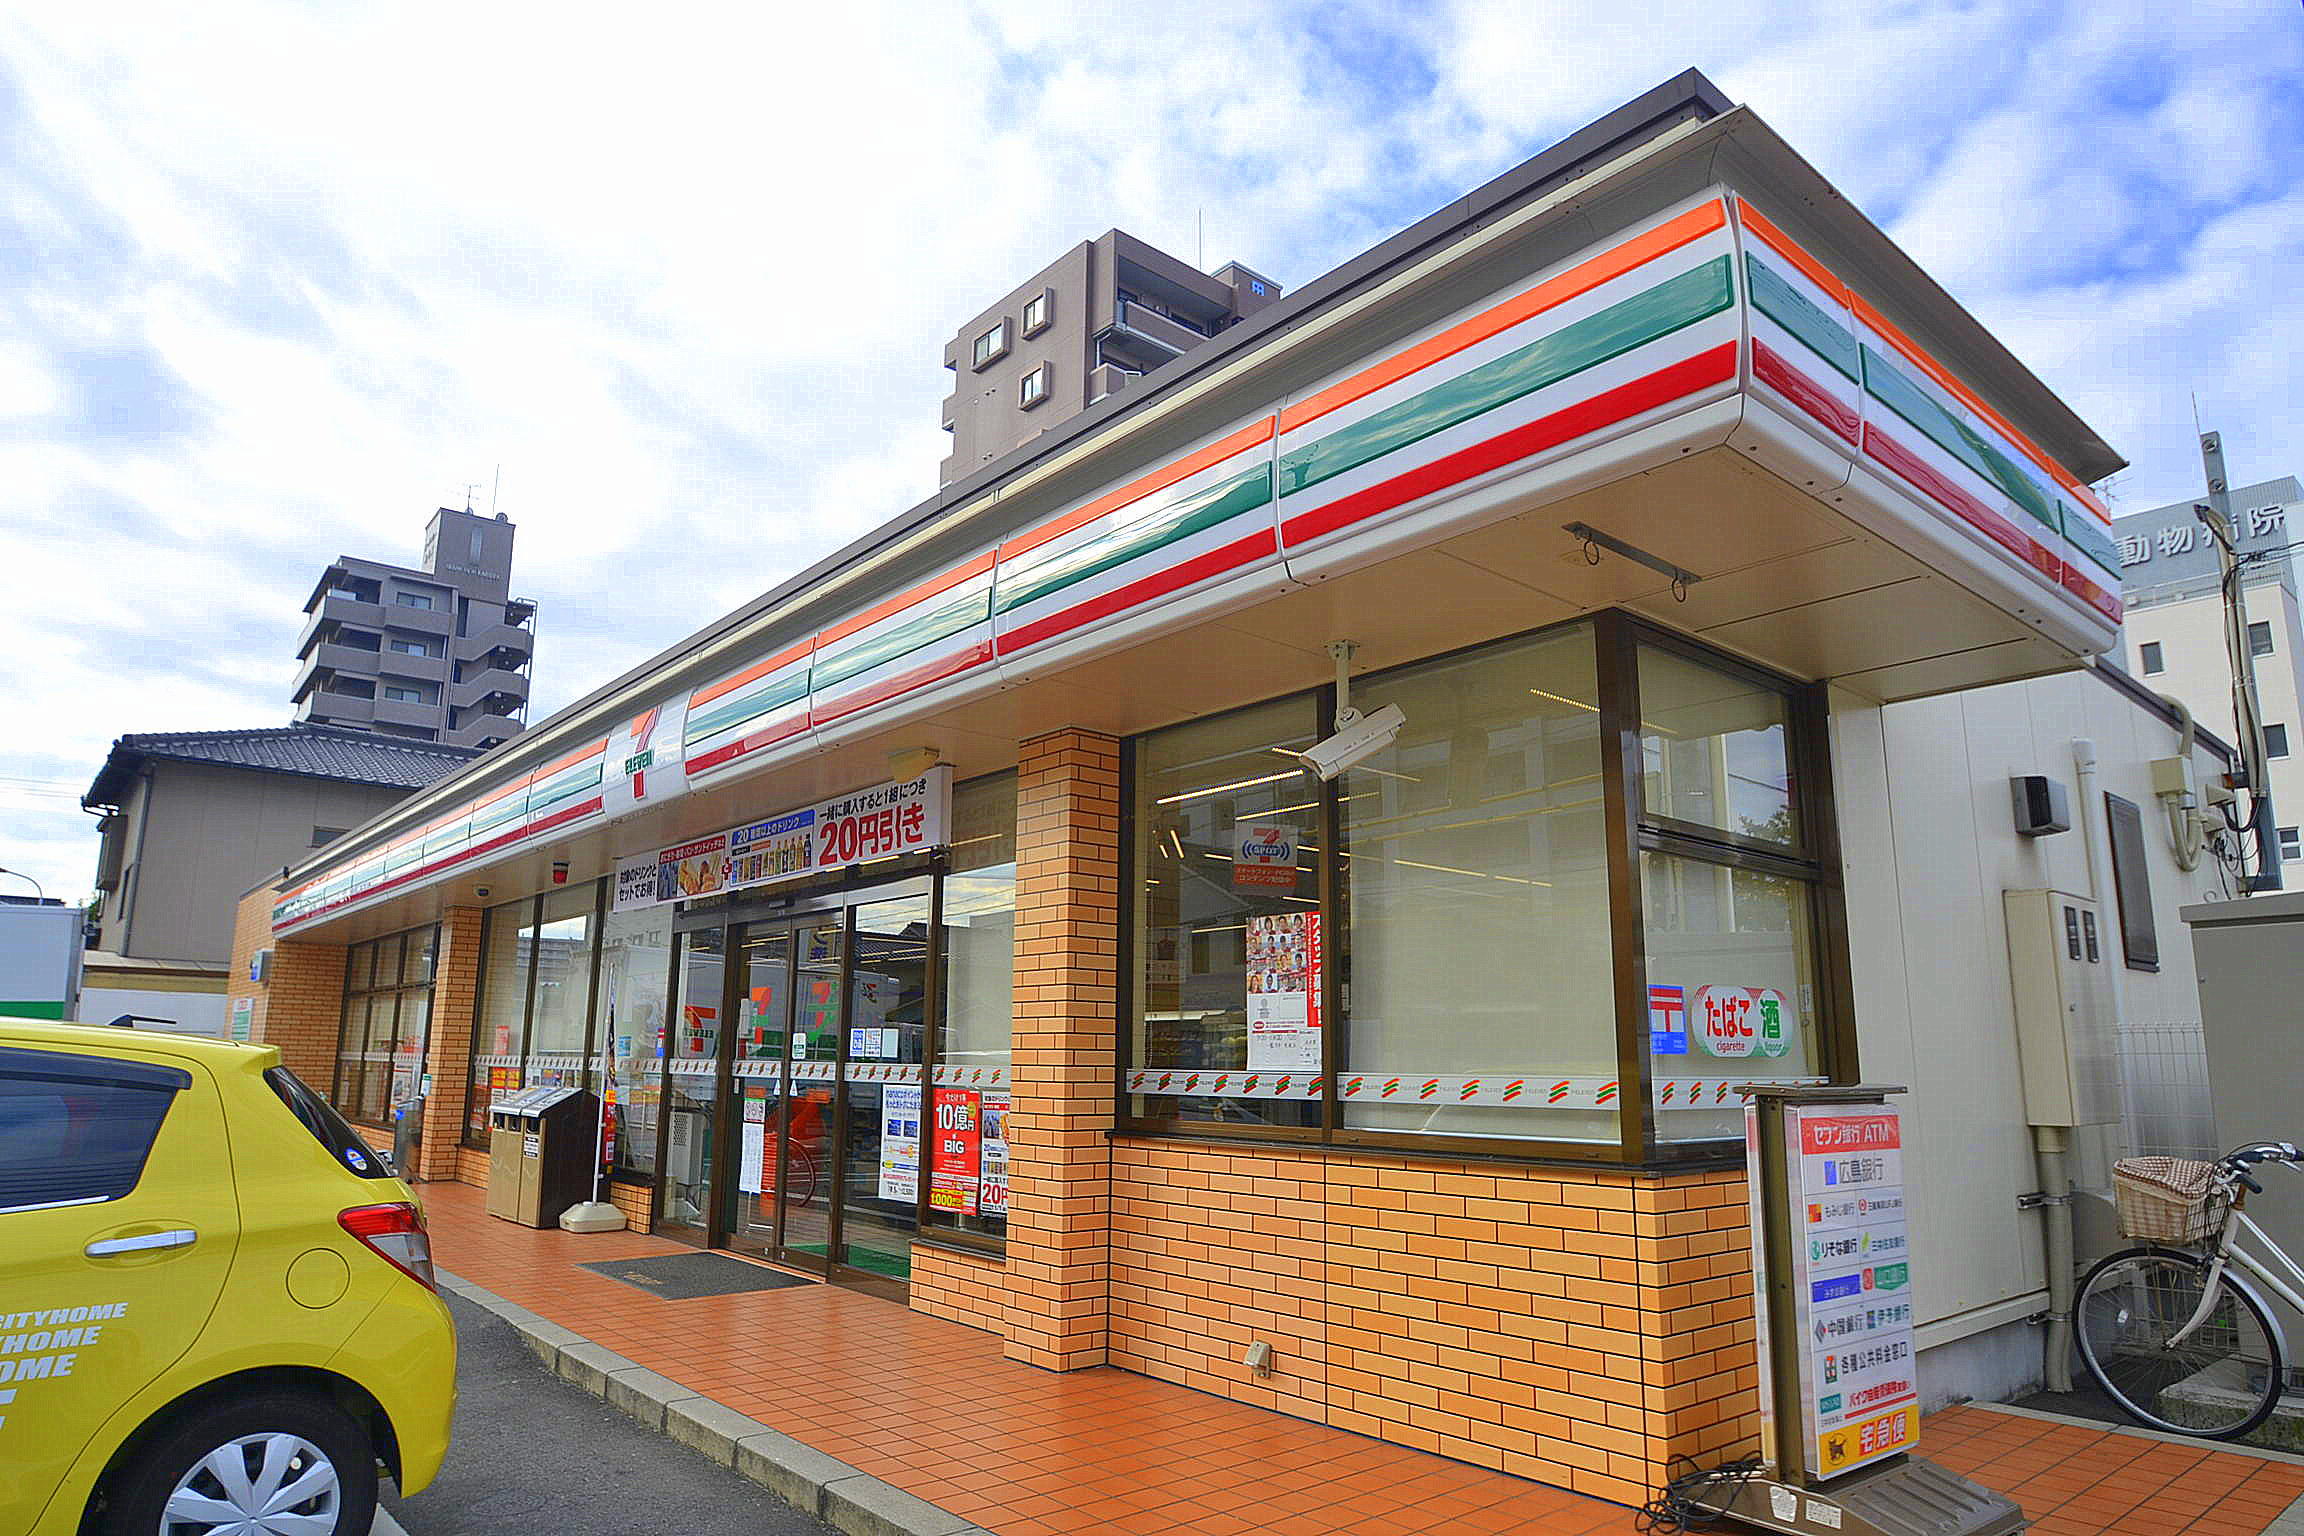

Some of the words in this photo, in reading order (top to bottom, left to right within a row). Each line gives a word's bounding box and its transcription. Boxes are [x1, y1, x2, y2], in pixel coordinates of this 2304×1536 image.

[819, 801, 925, 867] 20円引き
[1704, 995, 1754, 1038] たばこ
[1759, 998, 1781, 1039] 酒
[943, 1140, 965, 1154] BIG
[1814, 1124, 1860, 1145] セブン銀行
[1864, 1123, 1889, 1144] ATM
[1839, 1157, 1884, 1184] 広島銀行
[1821, 1238, 1857, 1258] りそな銀行
[0, 1302, 128, 1329] ITYHOME
[1827, 1313, 1864, 1337] 中国銀行
[1860, 1412, 1906, 1453] 宅急便
